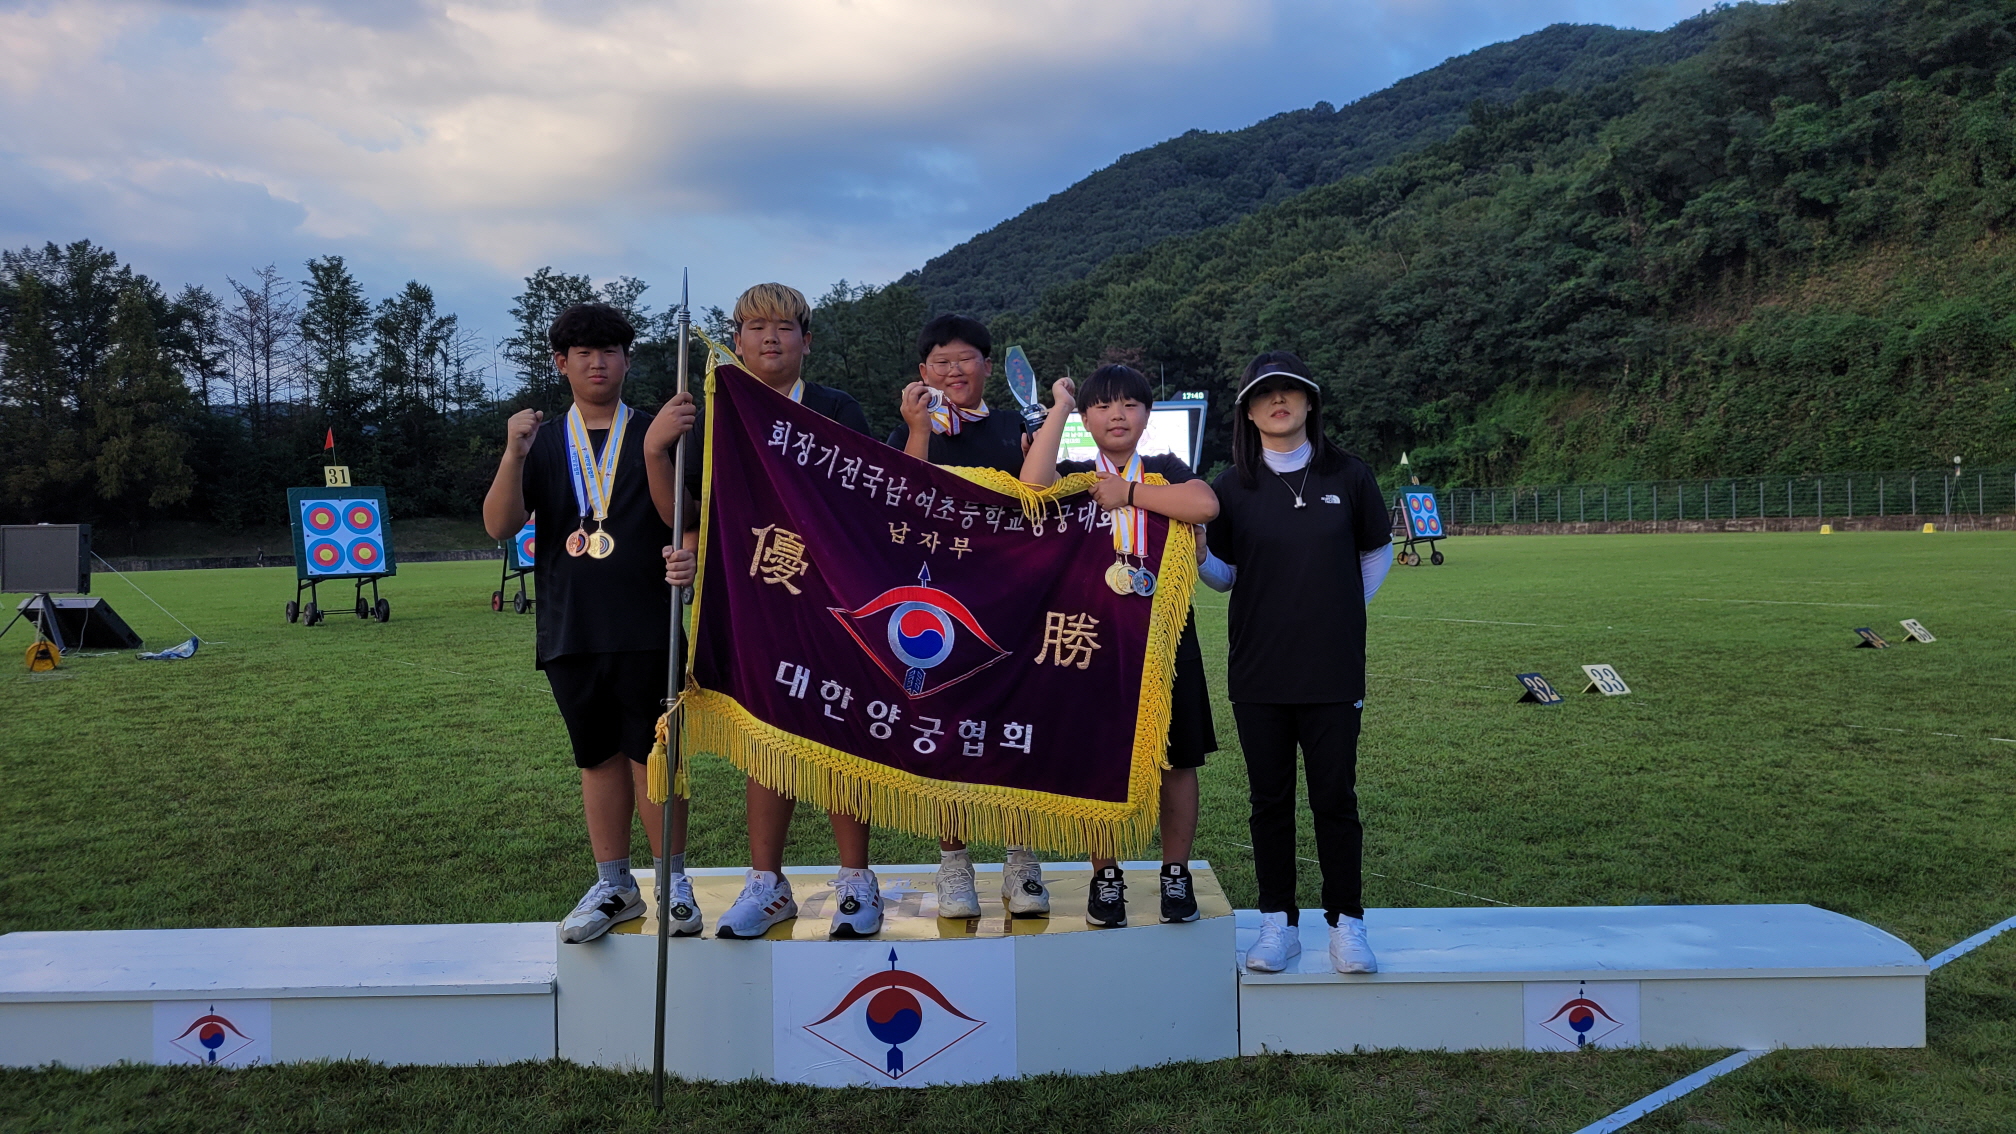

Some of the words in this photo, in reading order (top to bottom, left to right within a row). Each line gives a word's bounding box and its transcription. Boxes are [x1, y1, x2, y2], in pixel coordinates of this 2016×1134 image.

[1182, 391, 1204, 400] 17:40
[328, 468, 348, 485] 31
[888, 521, 973, 560] 남자부
[749, 523, 809, 595] 優
[1034, 611, 1102, 670] 勝
[1860, 630, 1890, 648] 34
[1906, 622, 1932, 641] 35
[1524, 676, 1561, 702] 32
[1590, 668, 1626, 693] 33
